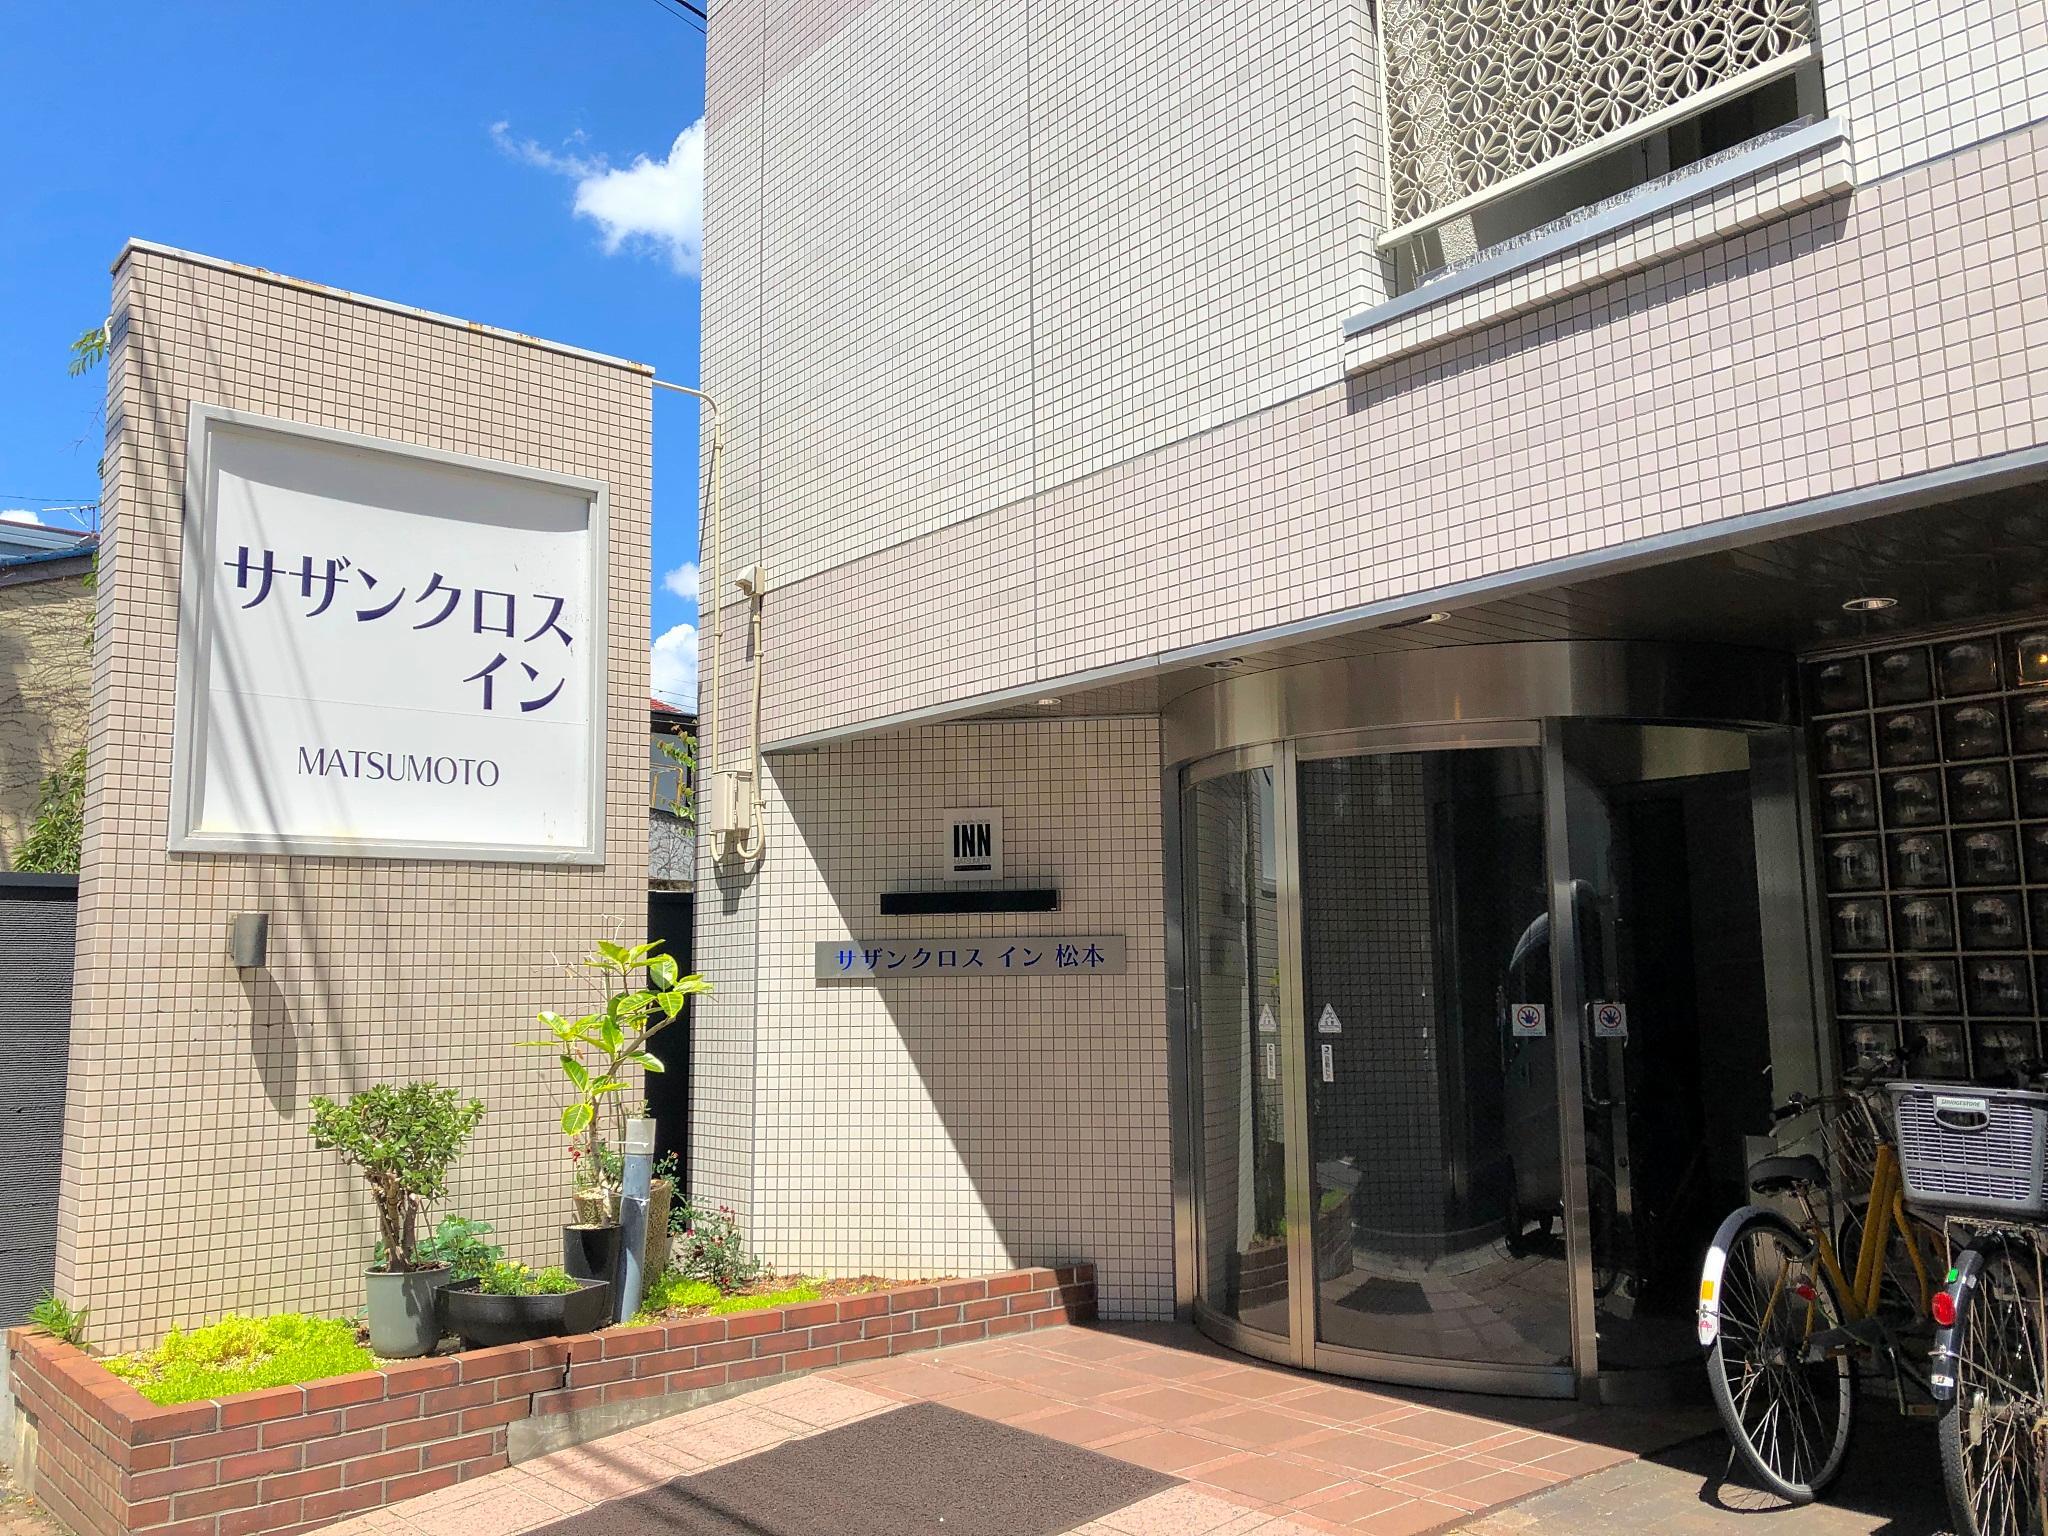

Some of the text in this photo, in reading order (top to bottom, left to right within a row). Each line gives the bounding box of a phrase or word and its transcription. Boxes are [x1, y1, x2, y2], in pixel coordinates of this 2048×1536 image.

[223, 545, 574, 647] サザンクロス
[462, 652, 566, 713] イン
[297, 745, 500, 787] MATSUMOTO
[953, 823, 991, 857] INN
[835, 943, 1105, 971] サザンクロス イン 松本
